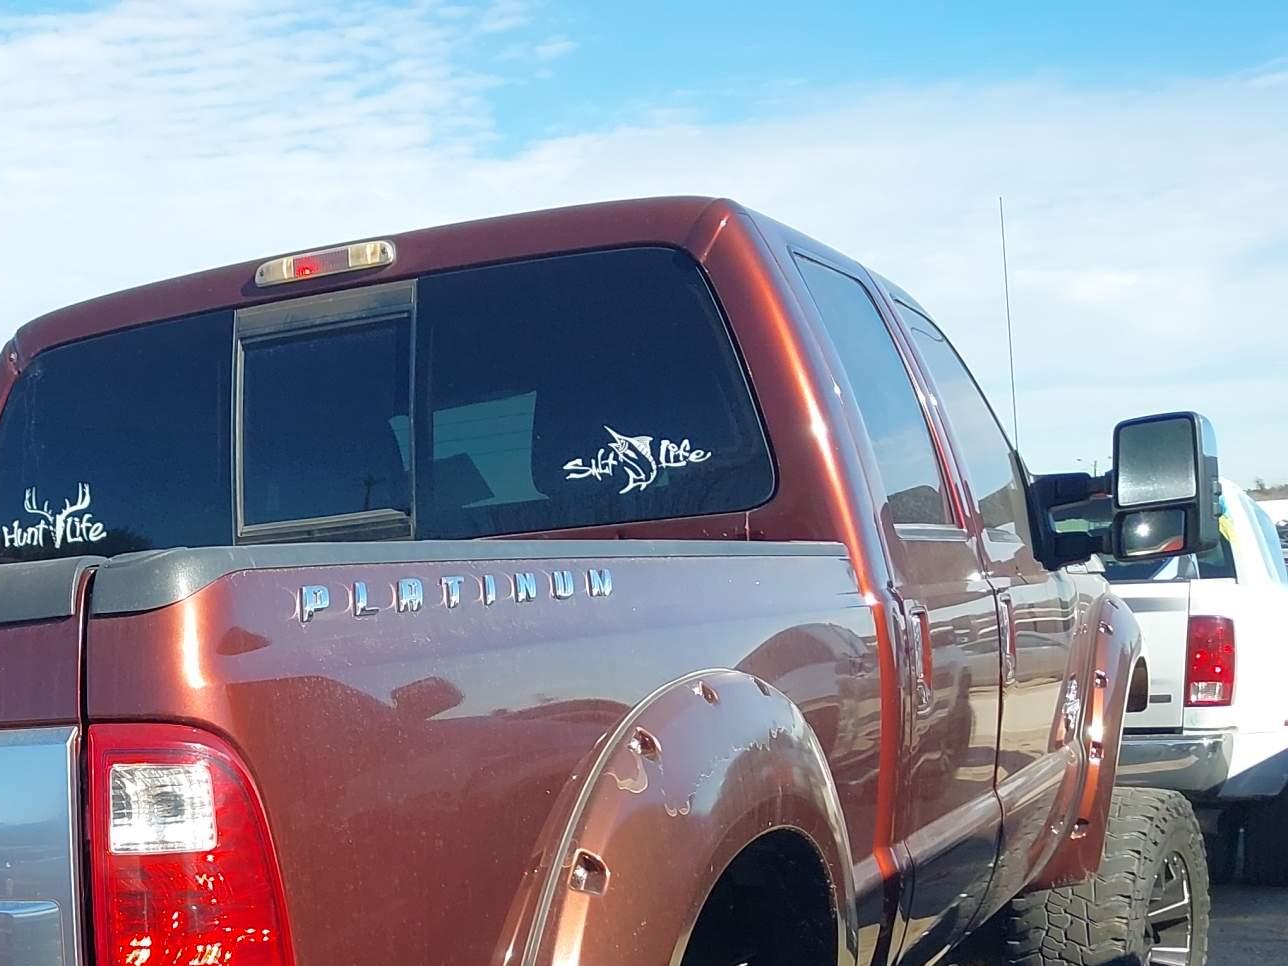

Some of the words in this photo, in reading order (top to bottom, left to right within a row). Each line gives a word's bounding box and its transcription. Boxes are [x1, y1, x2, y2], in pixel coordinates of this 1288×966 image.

[658, 438, 712, 468] Life
[1, 519, 48, 548] Hunt
[65, 513, 107, 543] Life
[298, 567, 613, 622] PLATINUM
